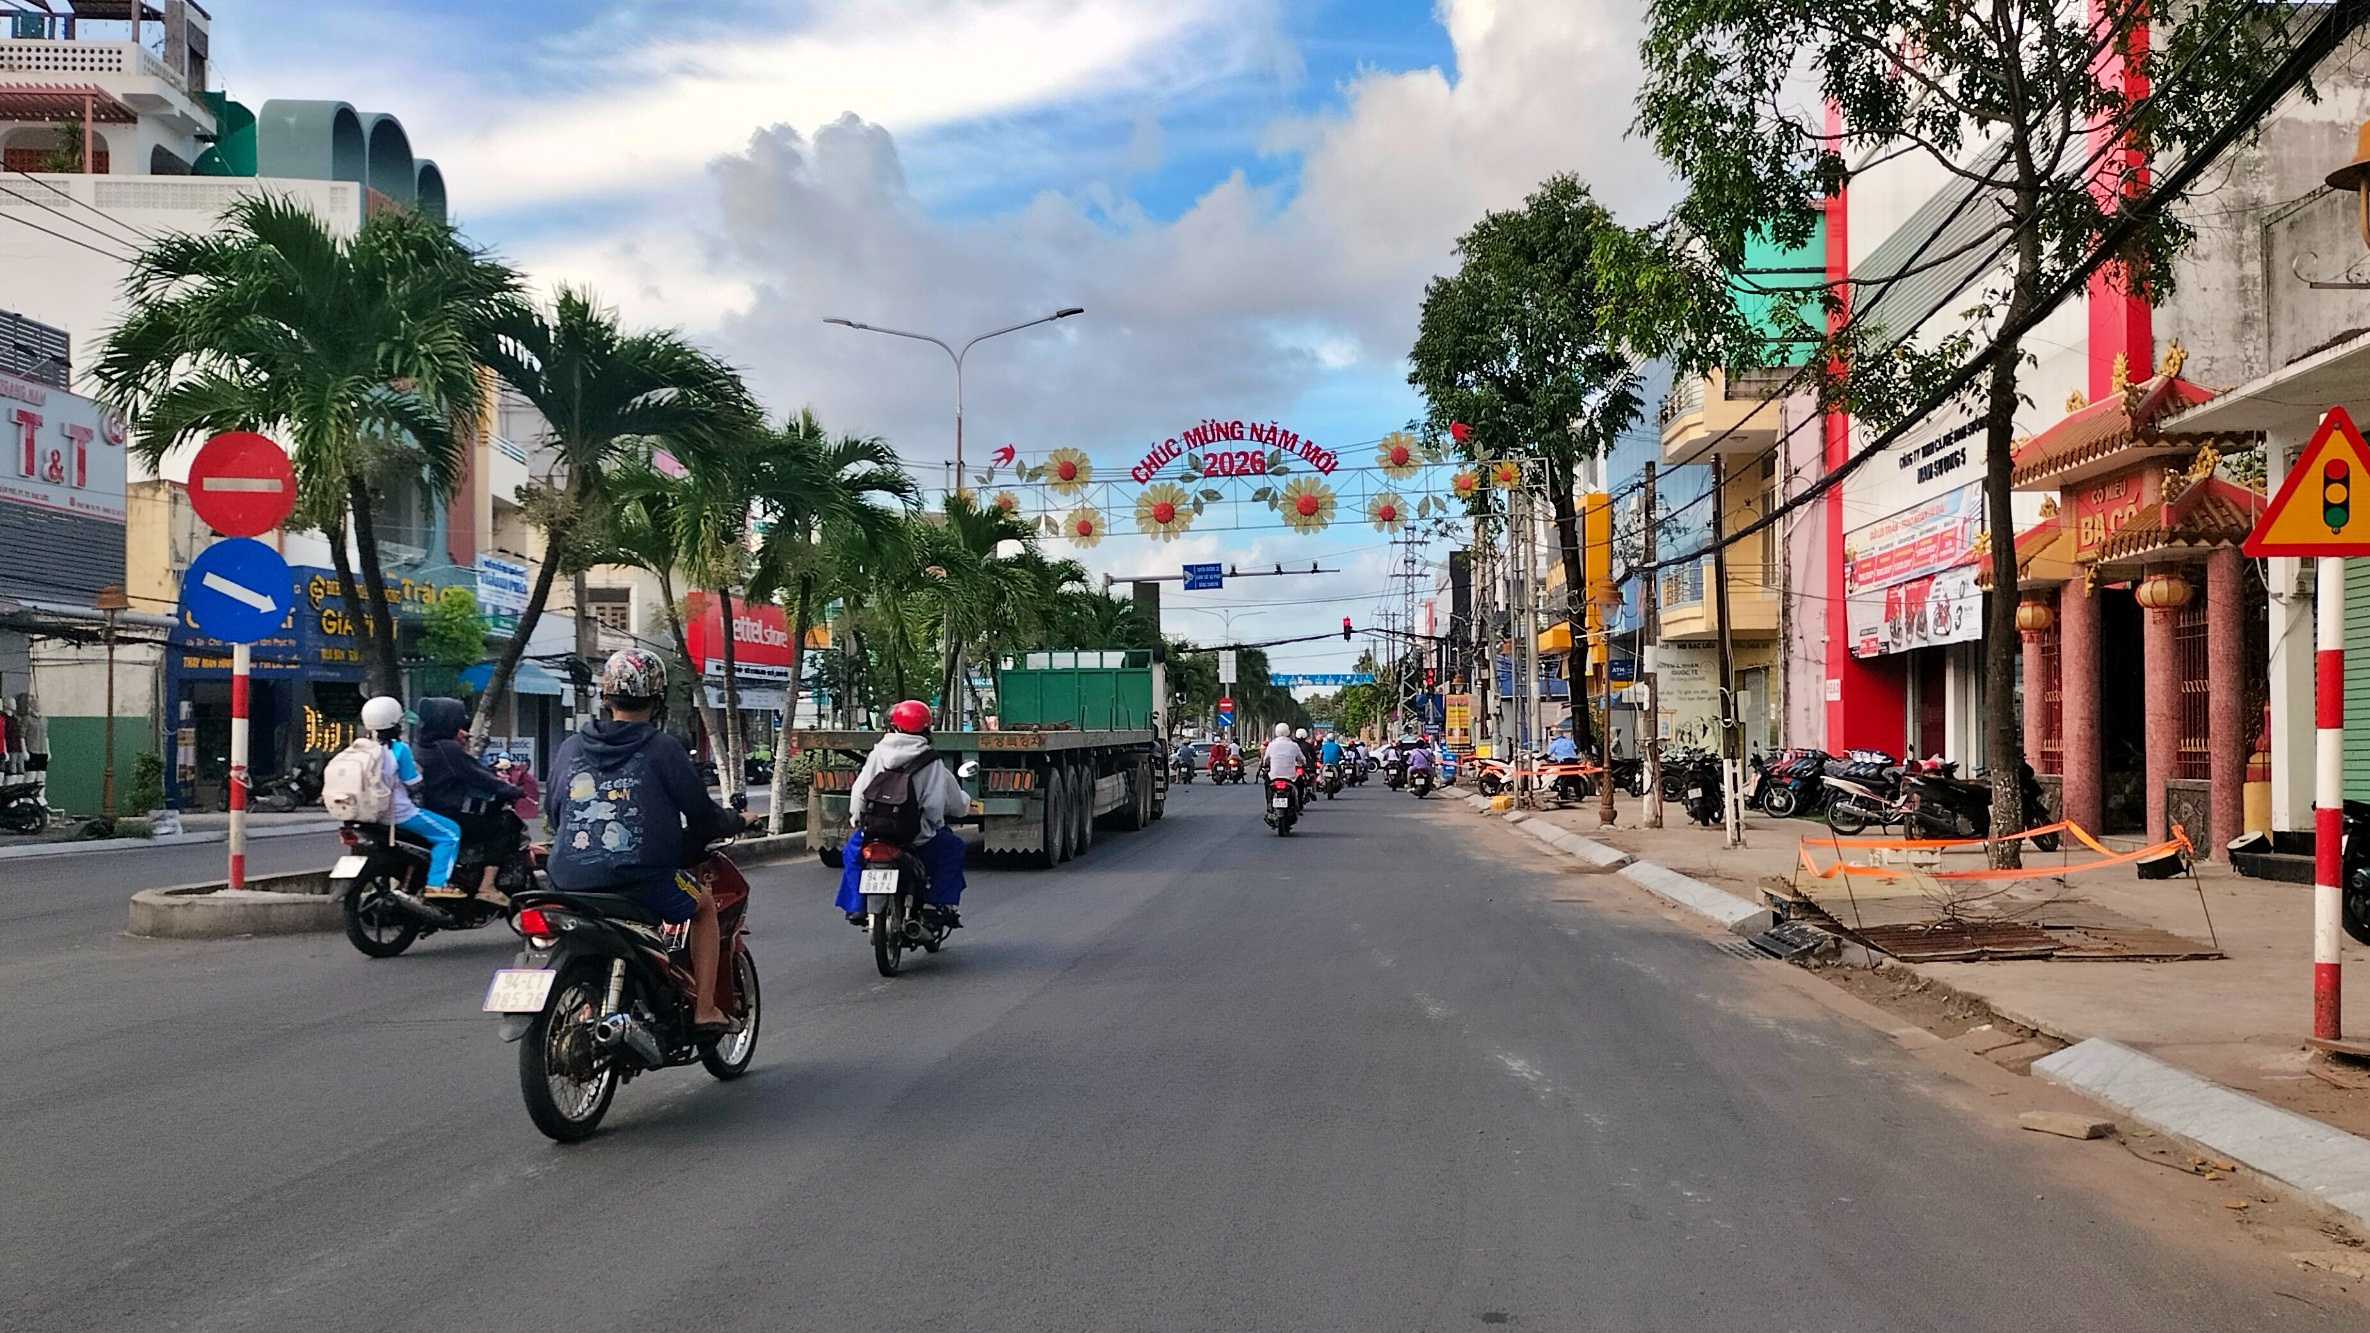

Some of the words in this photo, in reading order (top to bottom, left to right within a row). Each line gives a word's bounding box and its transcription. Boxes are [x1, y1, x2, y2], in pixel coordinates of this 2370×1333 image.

[1131, 438, 1182, 485] CHÚC
[1183, 419, 1244, 449] MỪNG
[1250, 420, 1299, 452] NĂM
[1300, 440, 1340, 476] MỚI
[1203, 450, 1265, 477] 2026
[1960, 447, 1966, 466] 5
[401, 577, 437, 604] Trái
[865, 882, 891, 892] 0874
